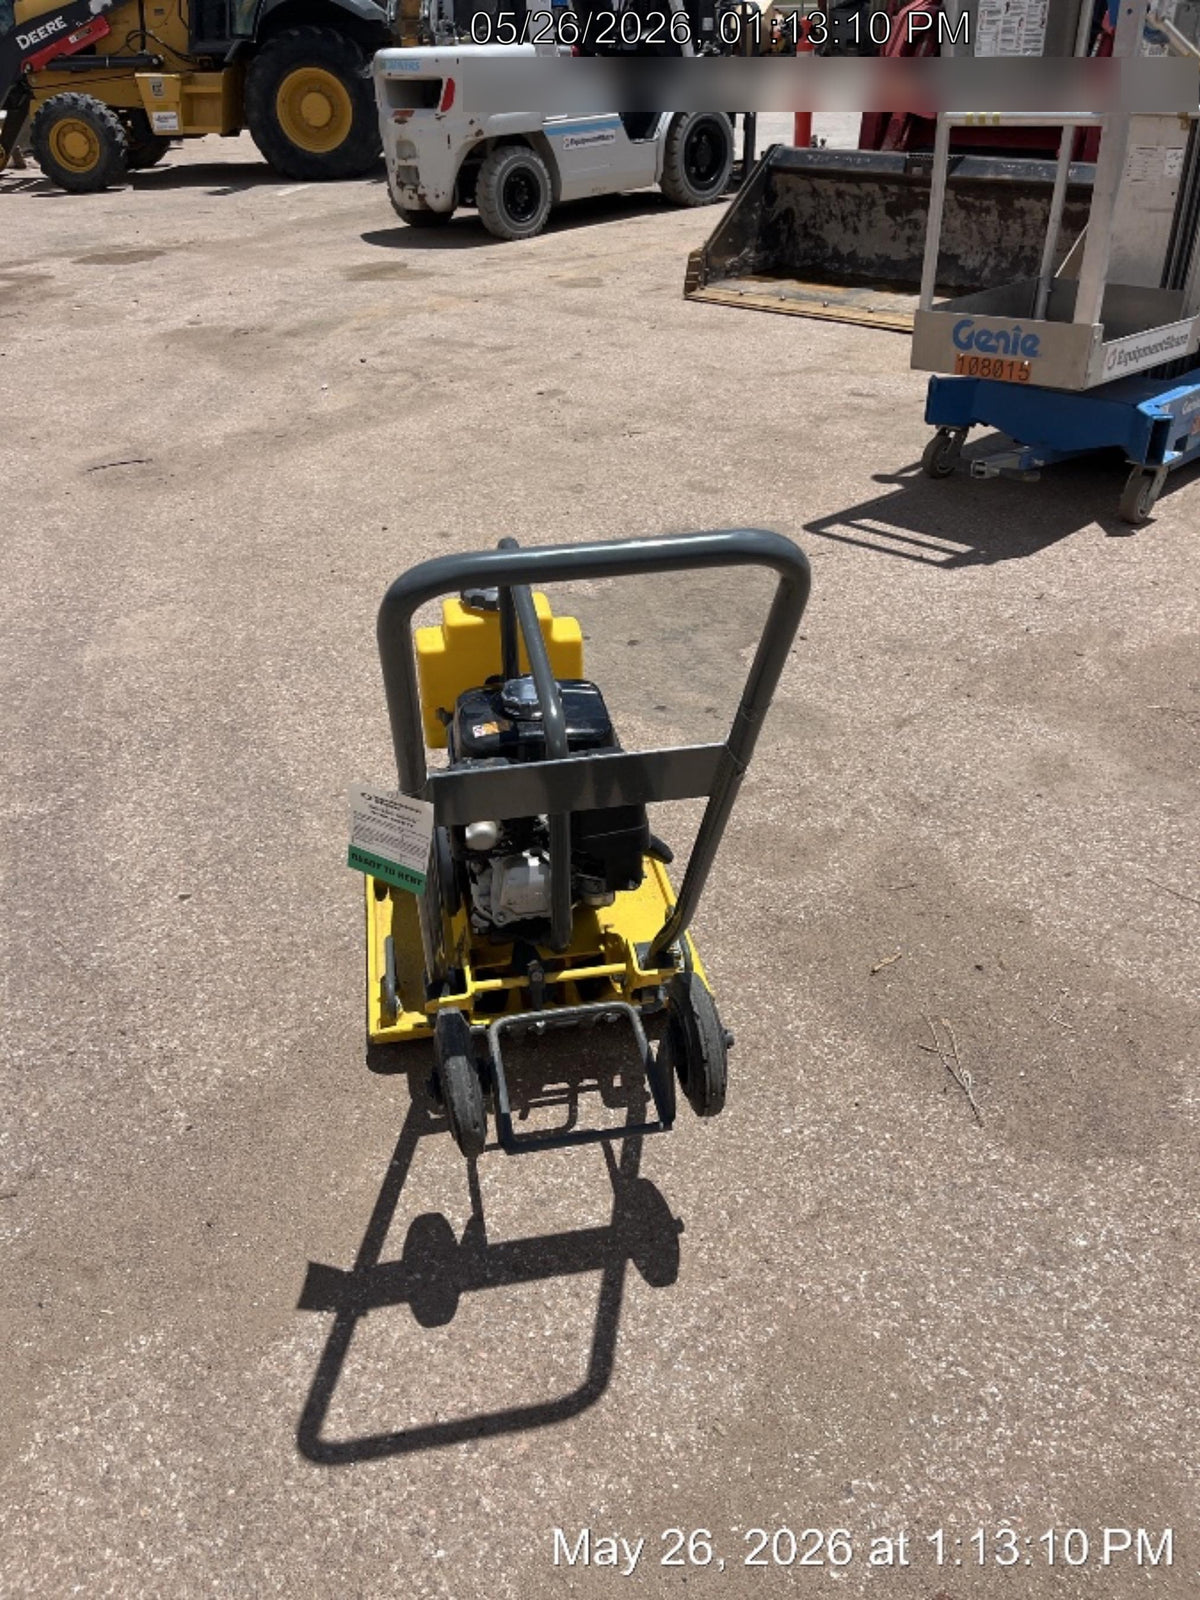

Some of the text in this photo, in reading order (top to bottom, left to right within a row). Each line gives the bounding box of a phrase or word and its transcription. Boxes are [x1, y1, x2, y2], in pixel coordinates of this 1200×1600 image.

[15, 16, 68, 50] DEERE
[953, 318, 1041, 358] Genie
[957, 354, 1031, 381] 108015
